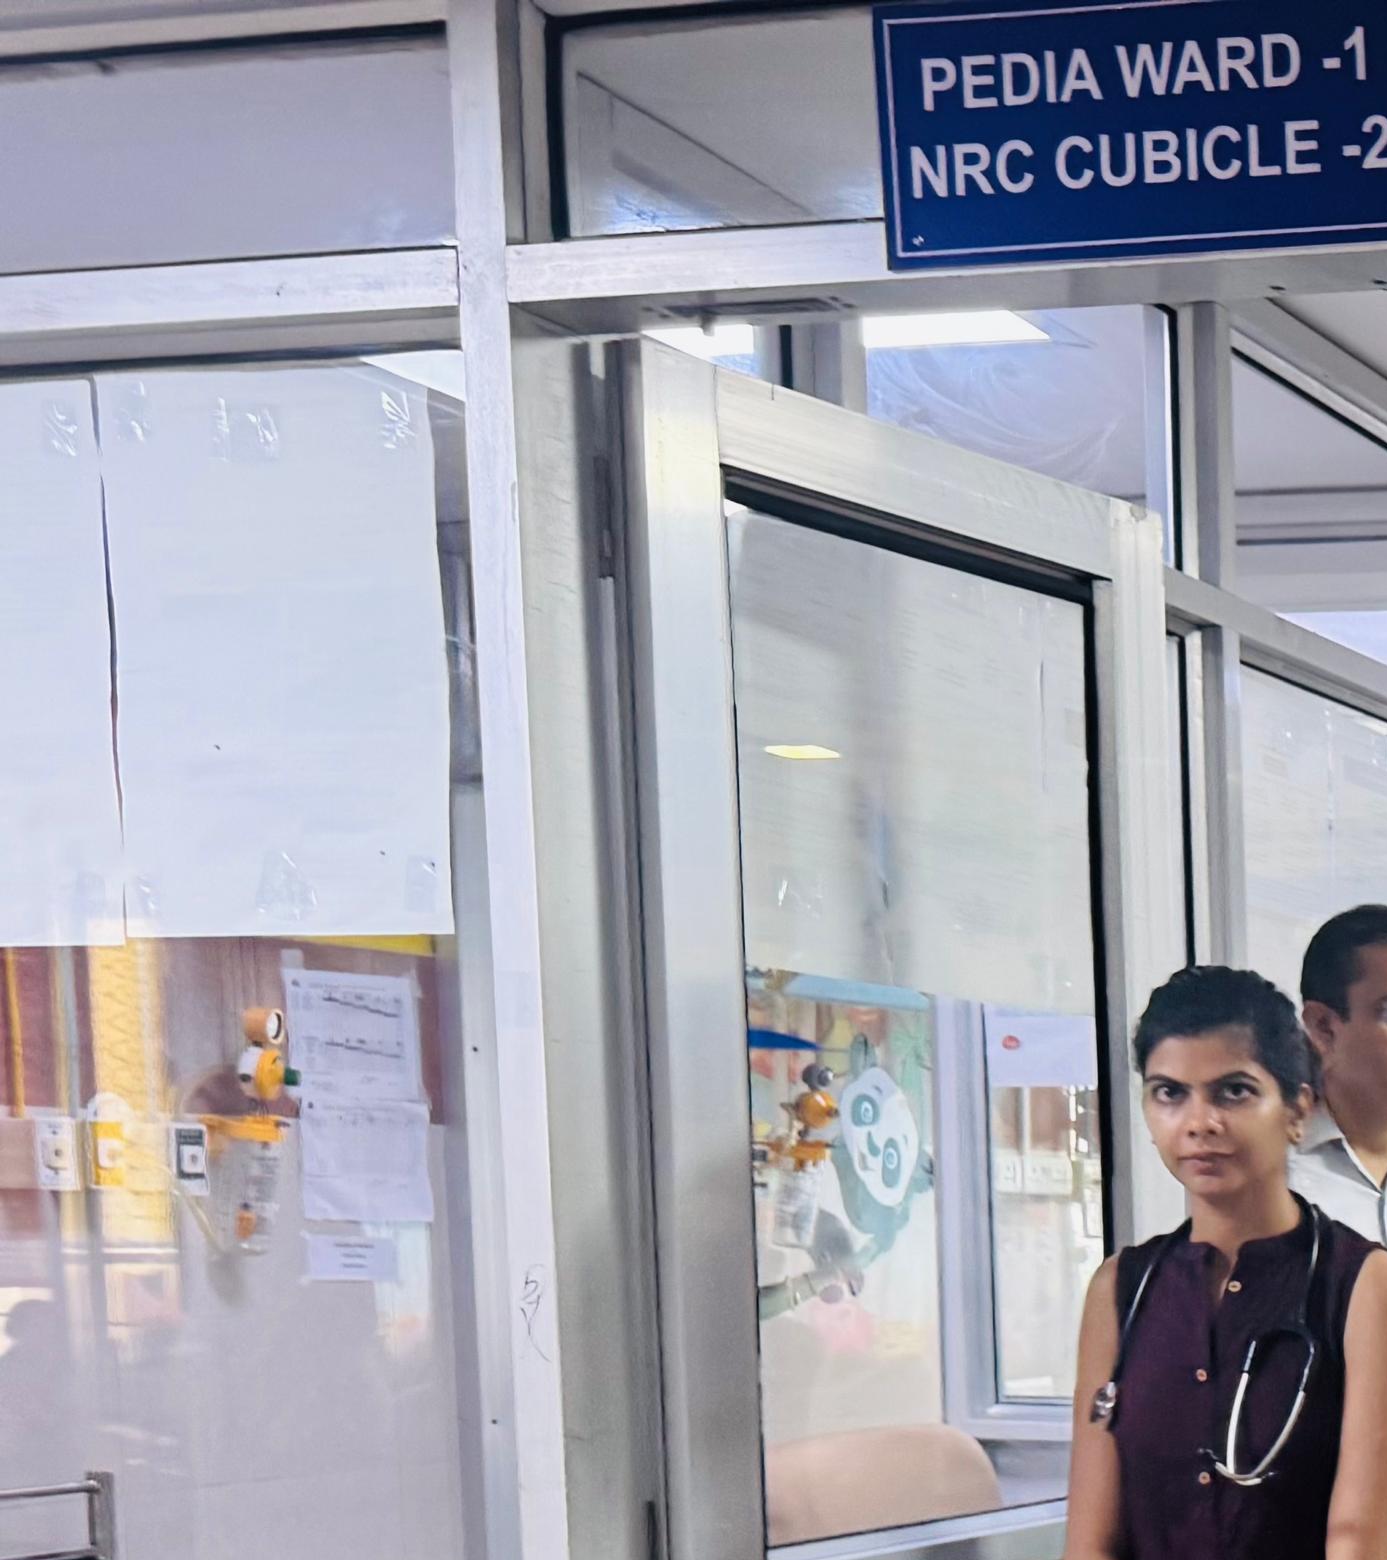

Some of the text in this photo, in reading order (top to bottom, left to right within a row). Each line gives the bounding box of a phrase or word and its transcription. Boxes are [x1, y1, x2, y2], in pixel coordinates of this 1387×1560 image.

[920, 26, 1367, 112] PEDIA WARD -1
[910, 139, 1034, 199] NRC
[1055, 120, 1321, 190] CUBICLE
